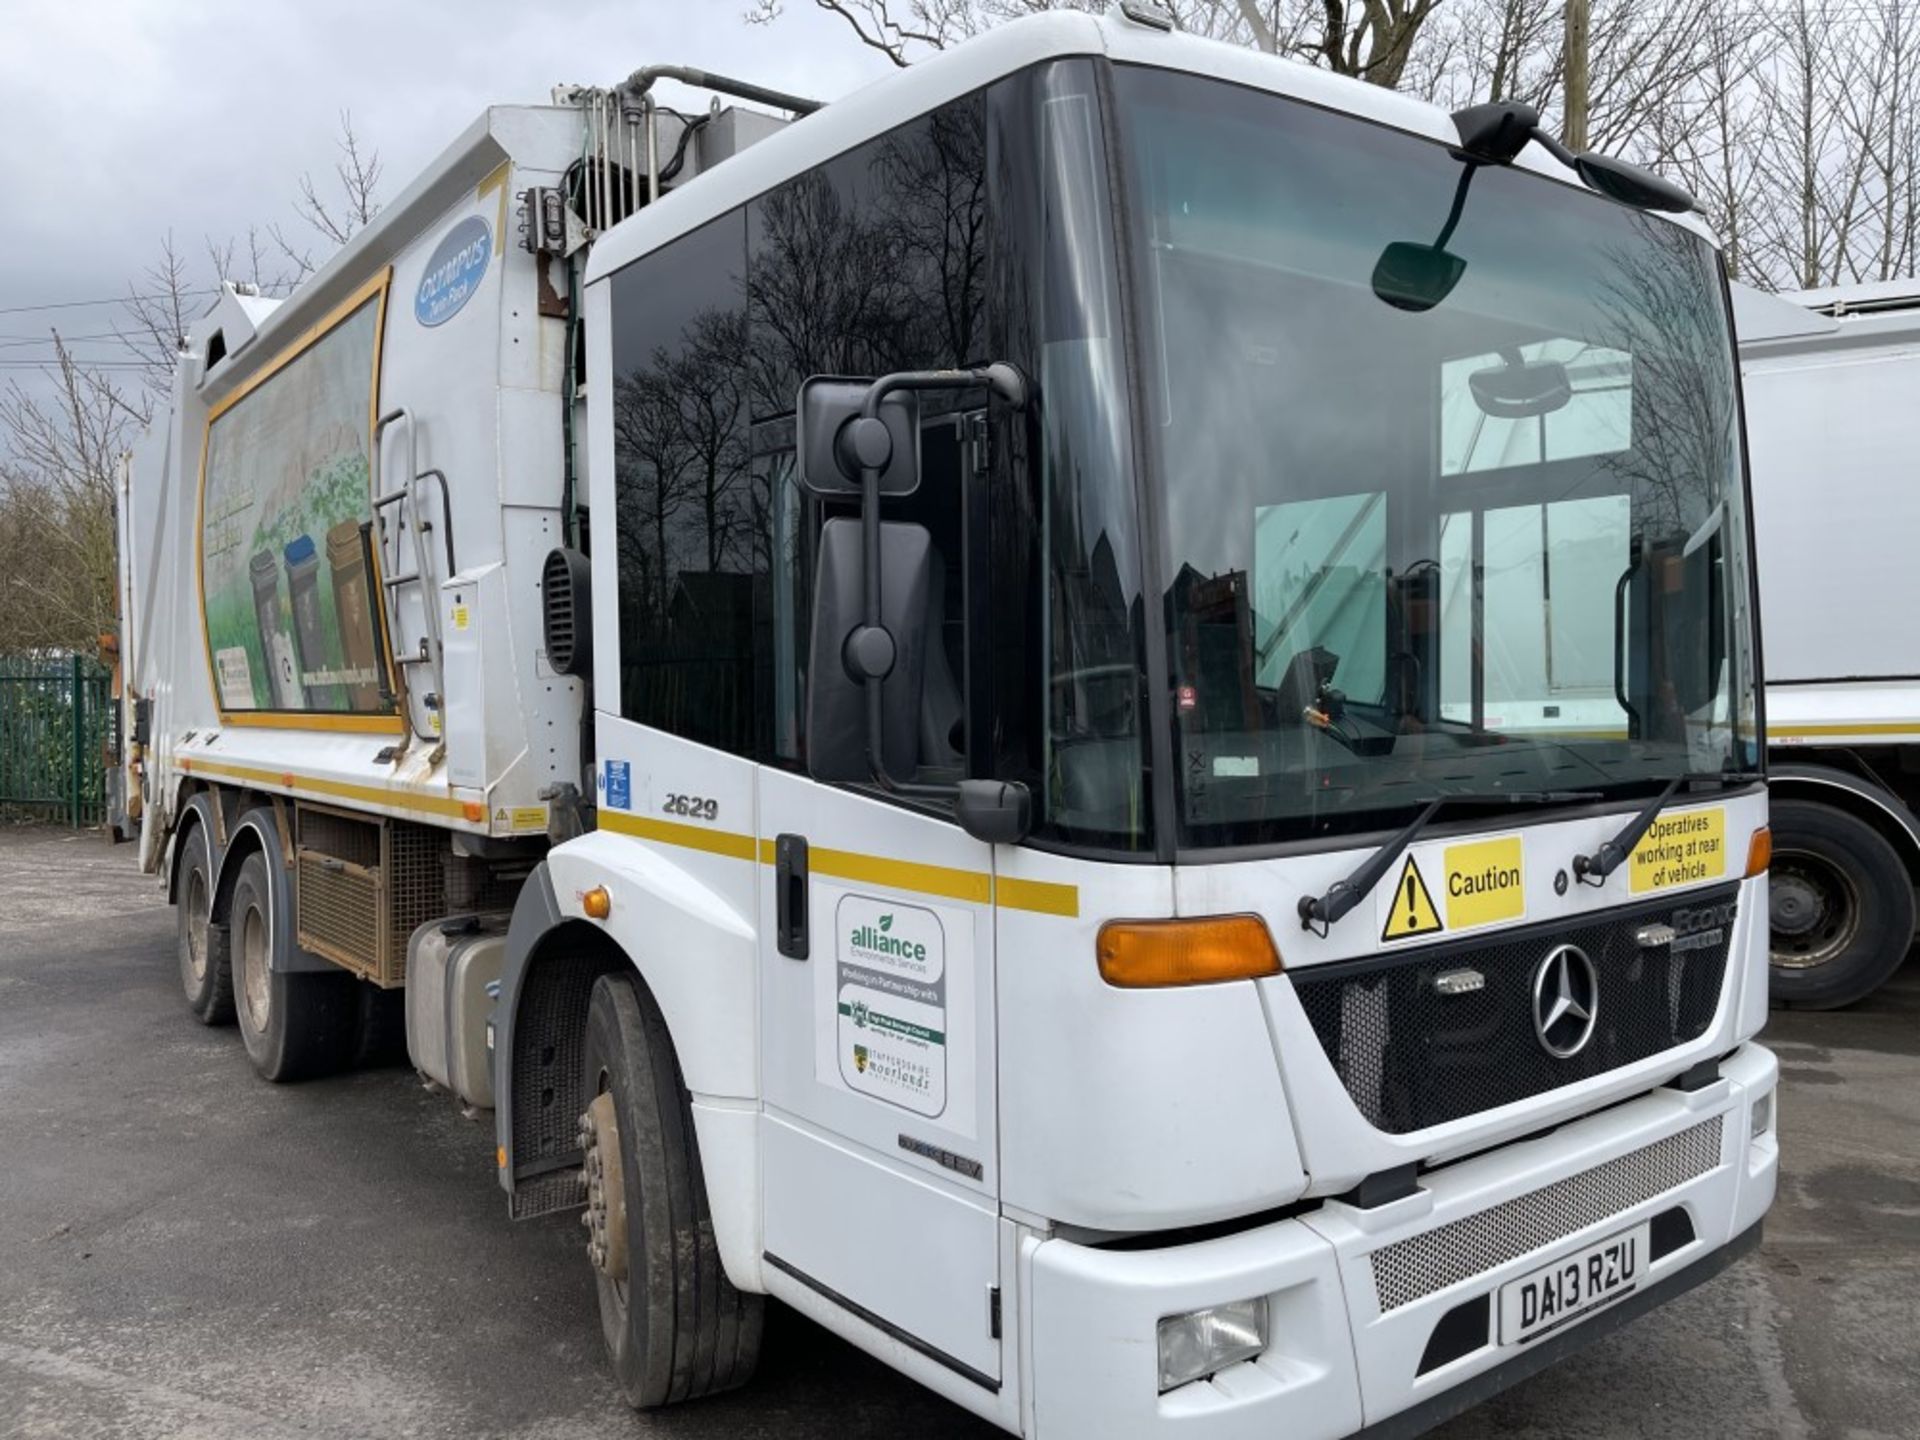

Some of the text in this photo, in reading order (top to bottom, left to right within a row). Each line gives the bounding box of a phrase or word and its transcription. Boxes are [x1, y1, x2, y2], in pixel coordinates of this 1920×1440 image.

[419, 234, 487, 304] OLYMPUS
[662, 792, 719, 821] 2629
[1648, 814, 1709, 841] Operatives
[1636, 838, 1720, 868] working at rear
[1448, 865, 1521, 897] Caution
[1653, 862, 1706, 887] of vehicle
[851, 924, 926, 962] alliance
[1521, 1238, 1636, 1329] DA13 RZU
